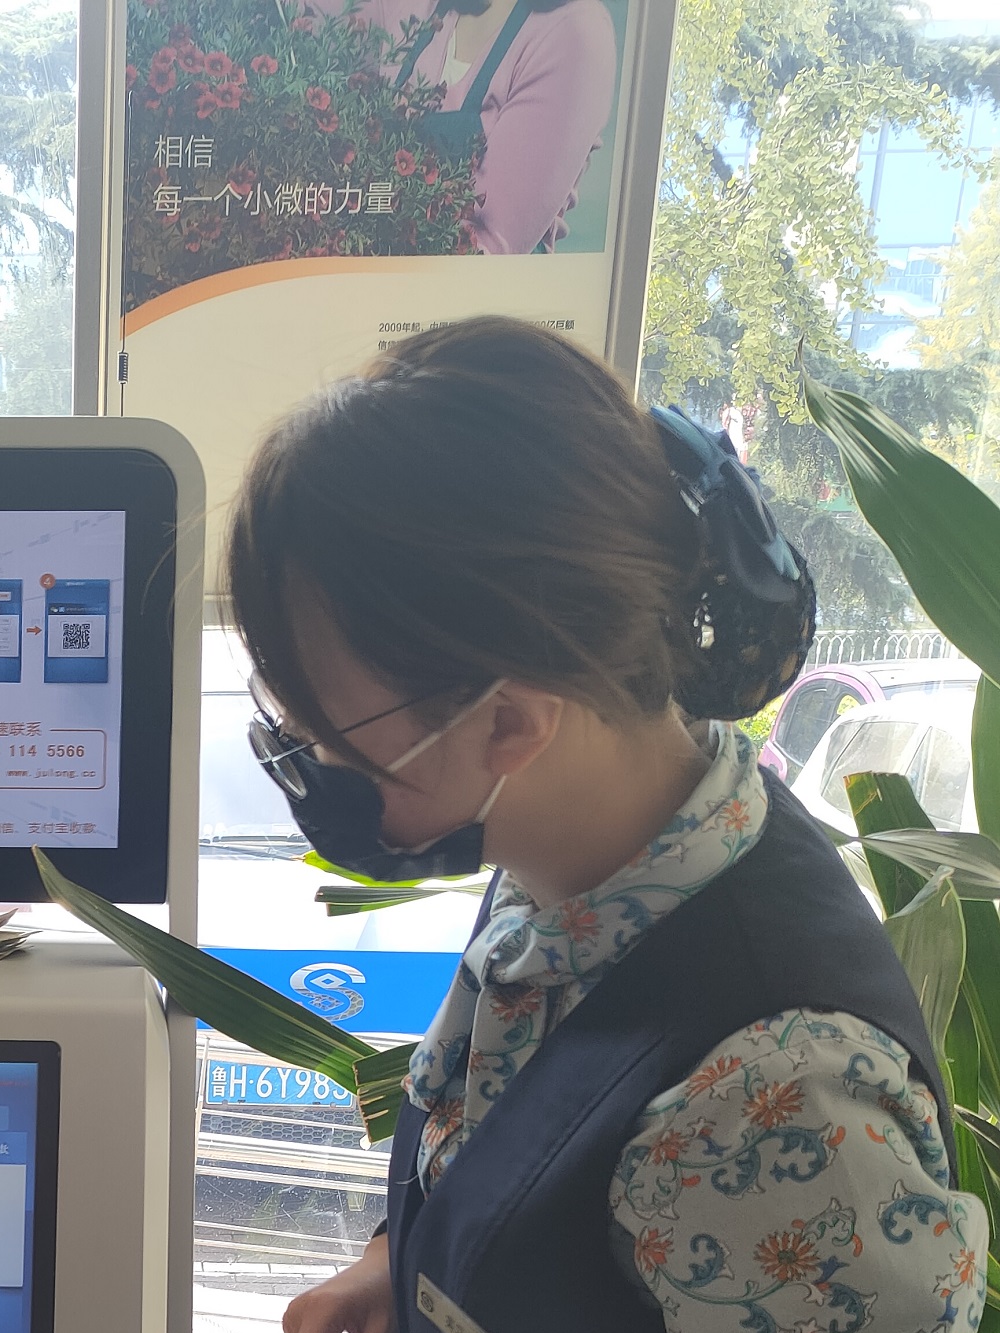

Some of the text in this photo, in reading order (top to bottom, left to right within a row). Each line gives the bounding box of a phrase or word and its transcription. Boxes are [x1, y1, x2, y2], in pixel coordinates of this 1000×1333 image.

[153, 134, 215, 168] 相信
[152, 181, 396, 217] 每一个小微的力量
[9, 744, 37, 757] 114
[47, 744, 85, 757] 5566
